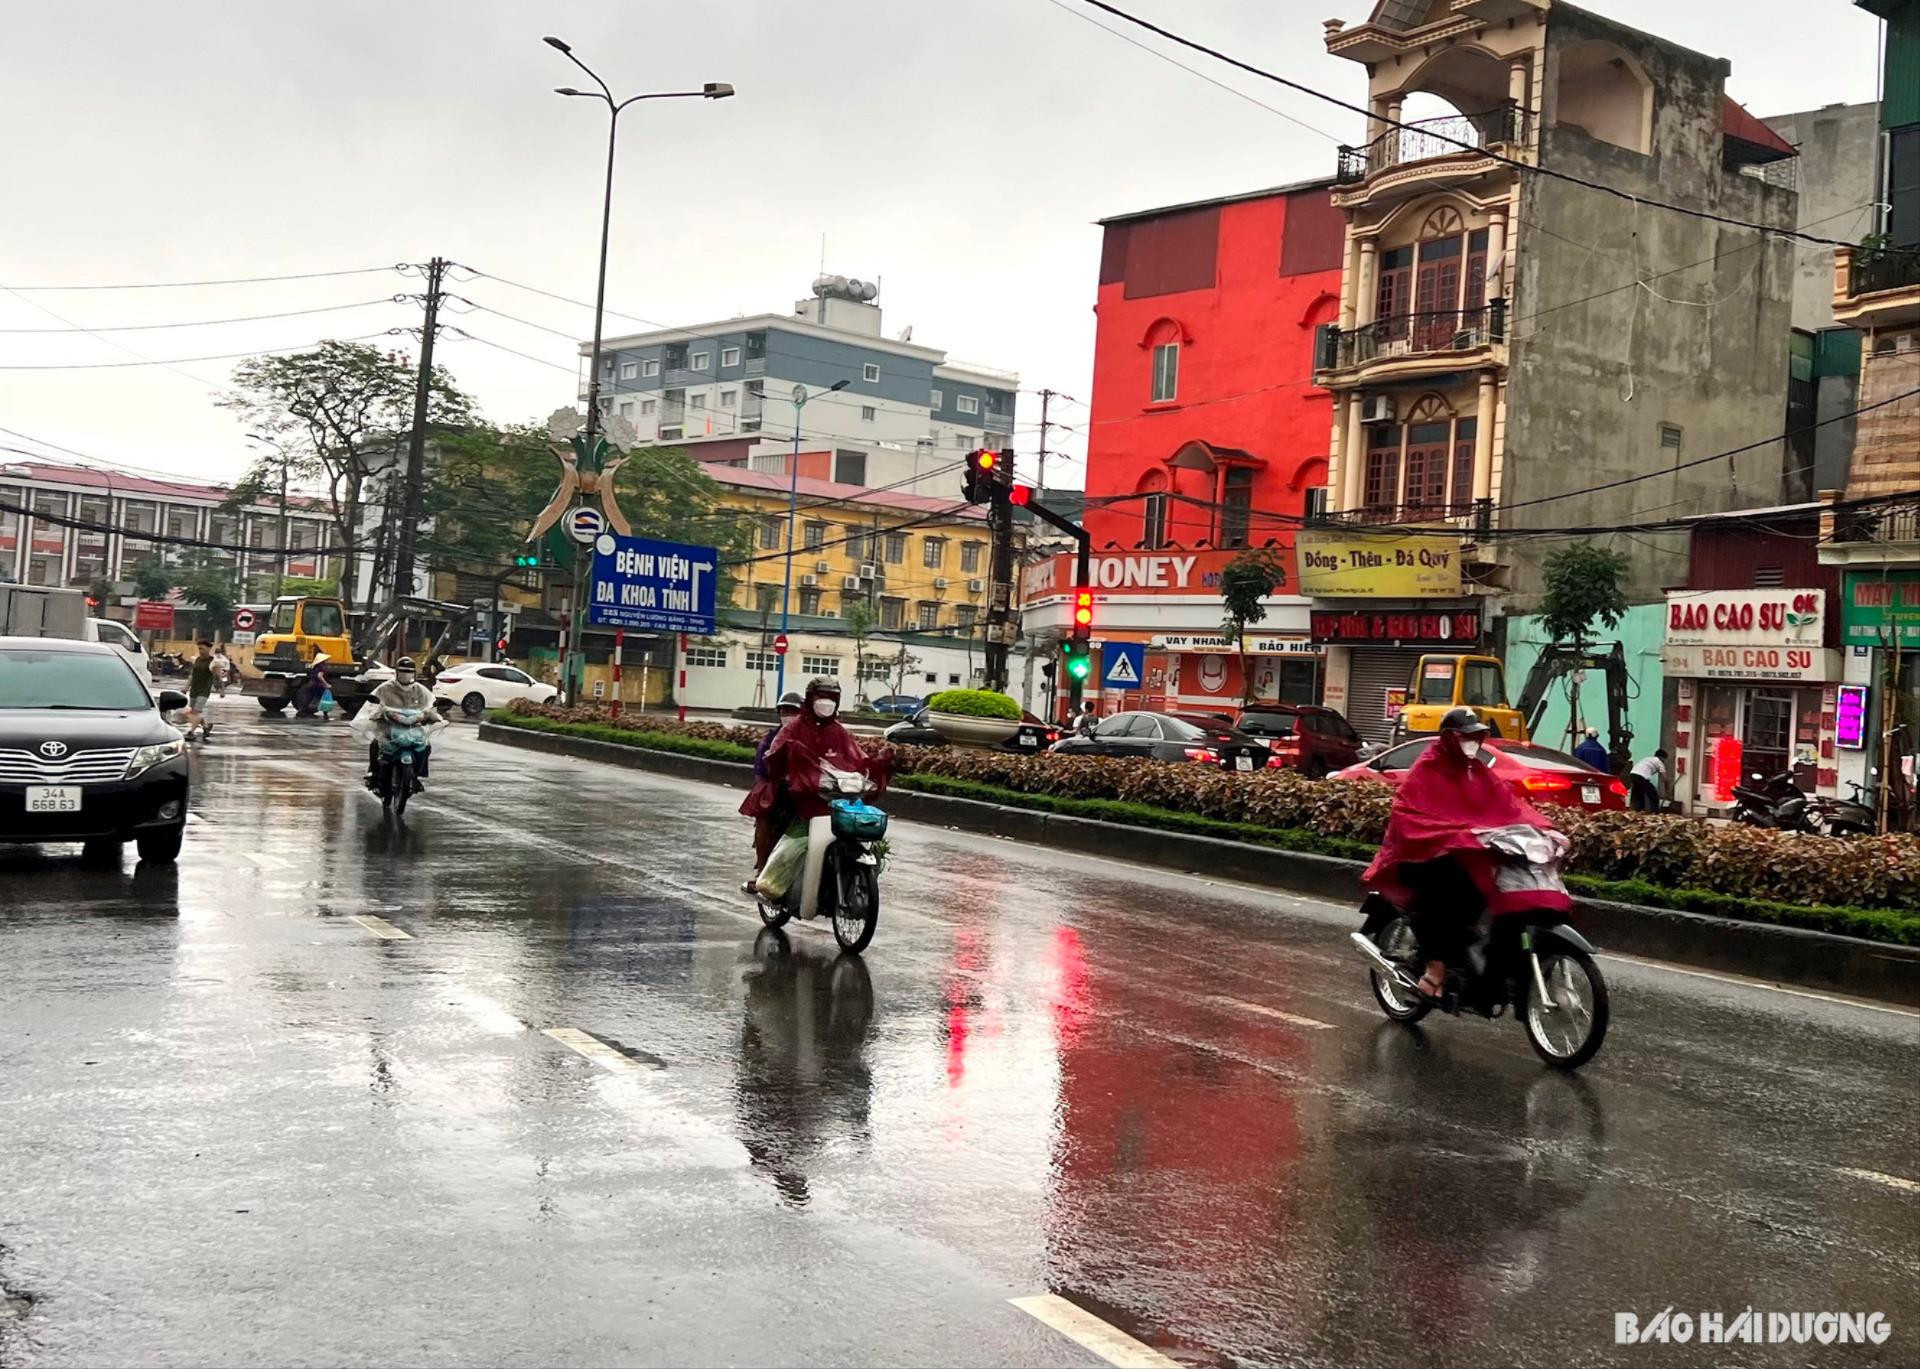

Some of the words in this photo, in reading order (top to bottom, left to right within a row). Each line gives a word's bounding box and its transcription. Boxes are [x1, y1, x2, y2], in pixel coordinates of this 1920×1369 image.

[616, 548, 654, 578] BỆNH
[658, 554, 689, 583] VIỆN
[1349, 551, 1382, 567] Thêu
[1396, 549, 1414, 566] Đá
[1419, 548, 1449, 568] Quý
[597, 581, 614, 603] ĐA
[621, 584, 656, 607] KHOA
[662, 582, 689, 611] TỈNH
[1793, 594, 1818, 613] OK
[1669, 604, 1708, 630] BAO
[1713, 603, 1753, 631] CAO
[1758, 603, 1786, 631] SU
[1166, 637, 1187, 645] VAY
[1703, 649, 1737, 667] BAO
[1744, 650, 1779, 668] CAO
[1787, 650, 1811, 668] SU
[42, 788, 65, 799] 34A
